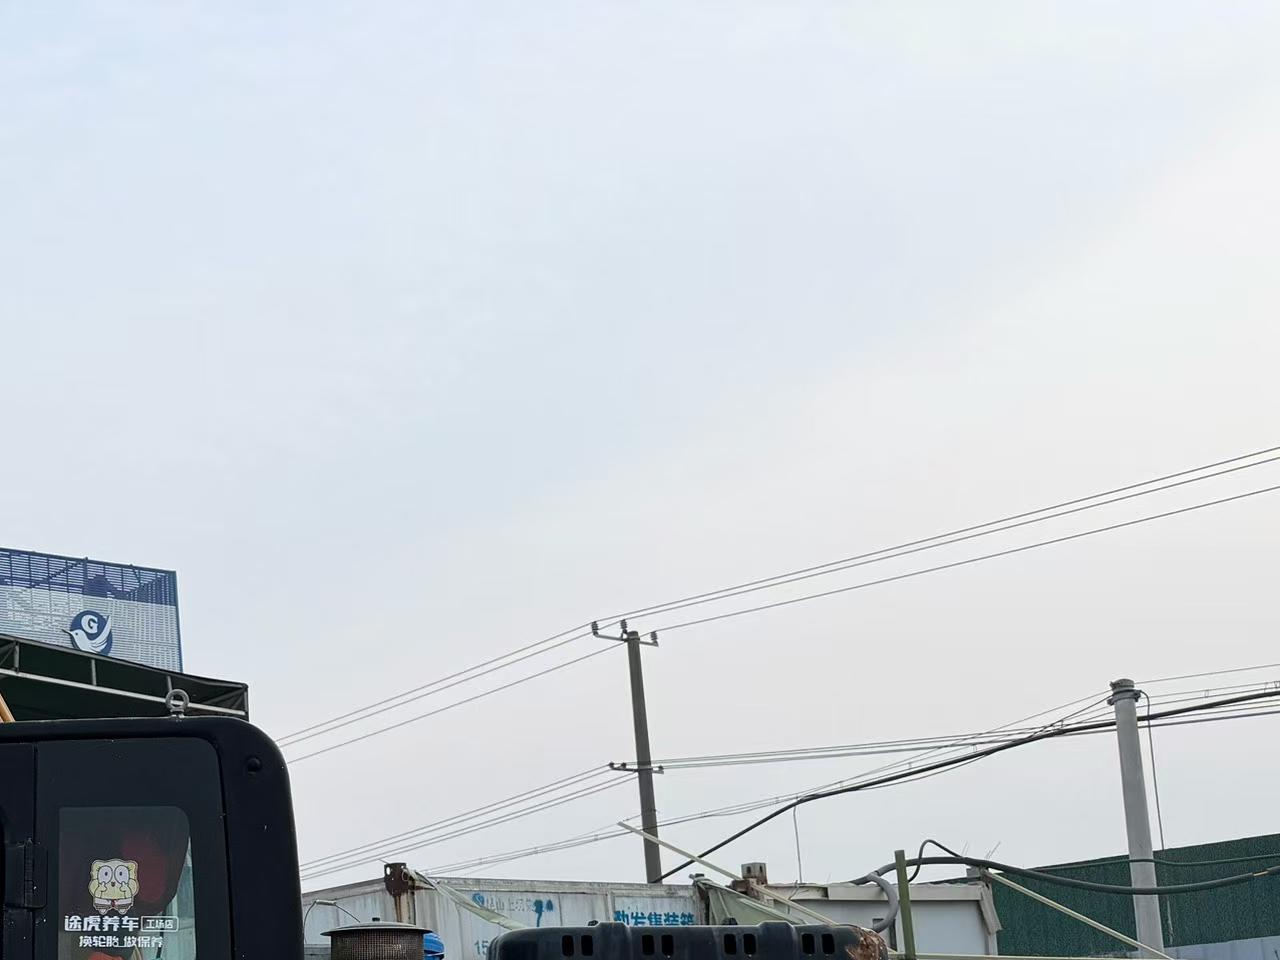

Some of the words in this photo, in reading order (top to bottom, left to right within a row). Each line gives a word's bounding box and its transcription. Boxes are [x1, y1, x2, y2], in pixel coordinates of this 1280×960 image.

[64, 915, 139, 932] 途虎养车
[145, 919, 174, 929] 工场店
[79, 935, 120, 948] 换轮胎
[123, 935, 164, 948] 做保养
